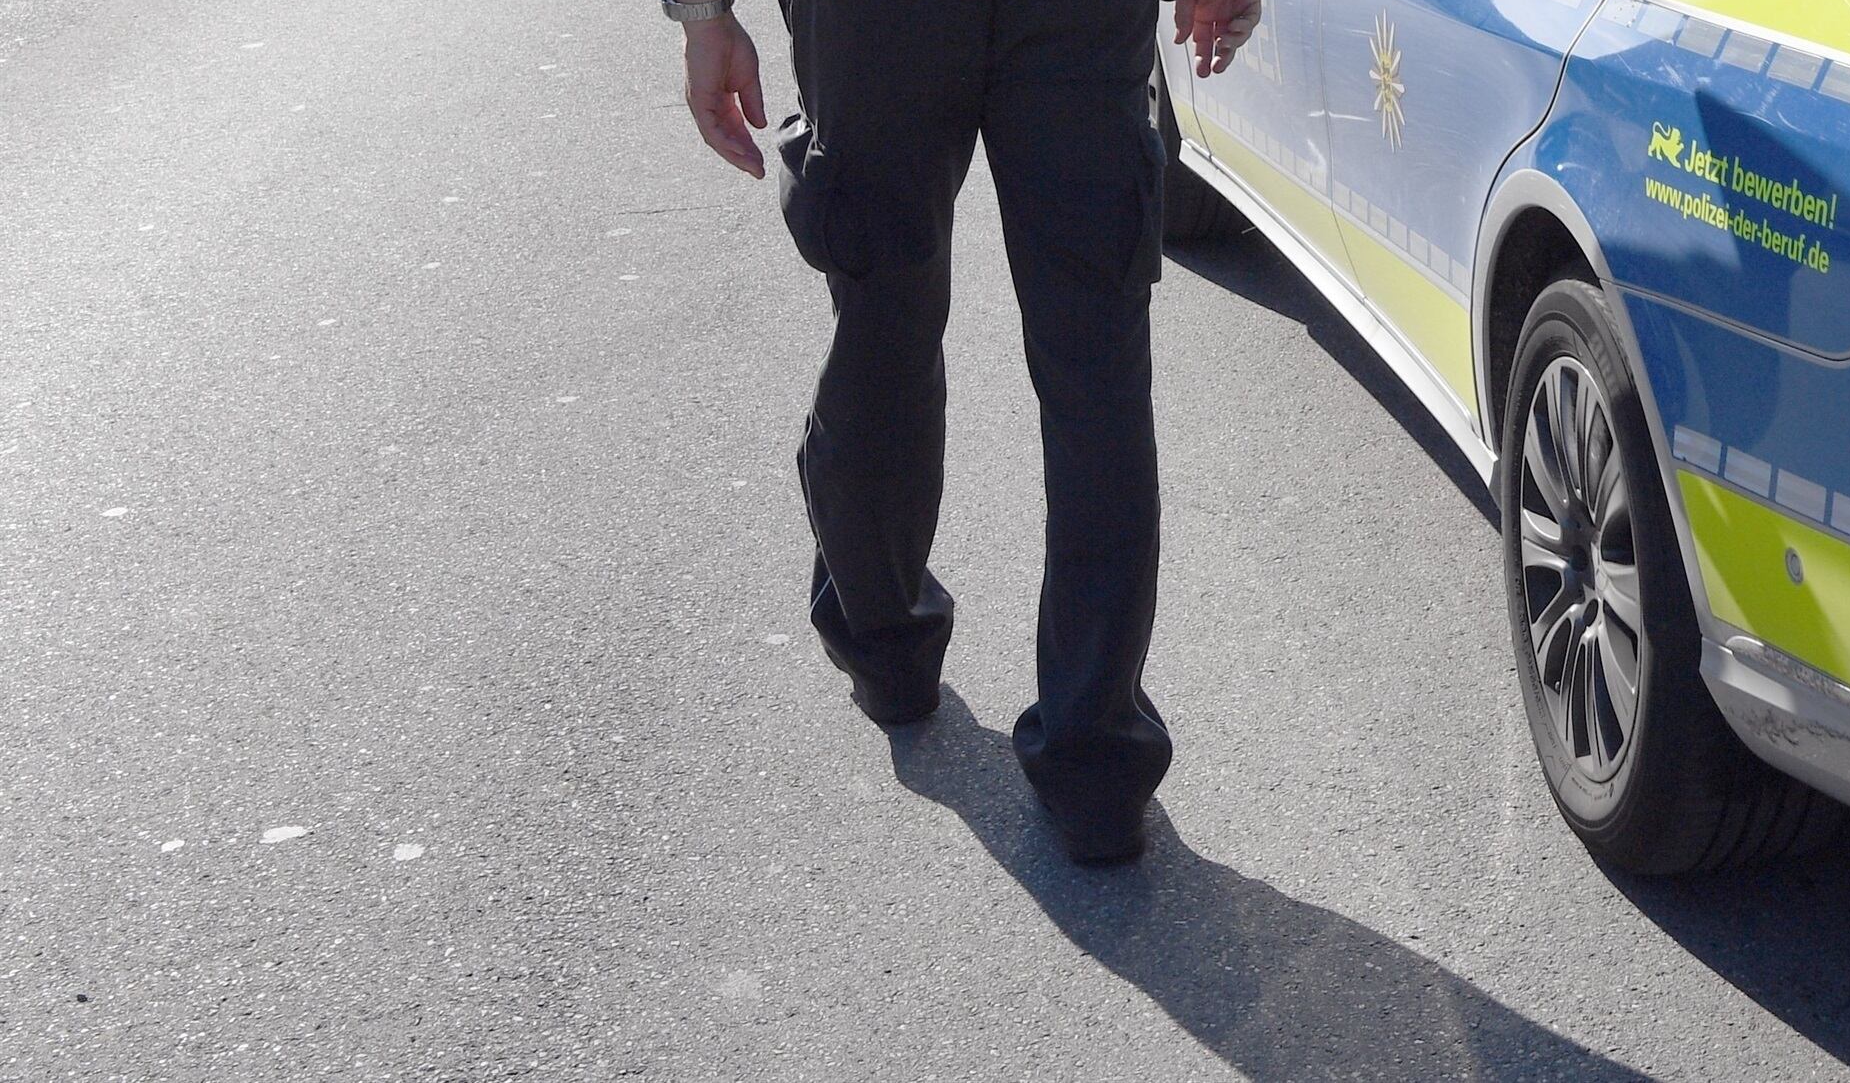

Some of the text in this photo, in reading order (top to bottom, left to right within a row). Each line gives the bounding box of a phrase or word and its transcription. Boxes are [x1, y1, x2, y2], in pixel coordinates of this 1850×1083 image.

[1645, 177, 1830, 274] www.polizei-der-beruf.de
[1684, 139, 1838, 230] Jetzt bewerben!
